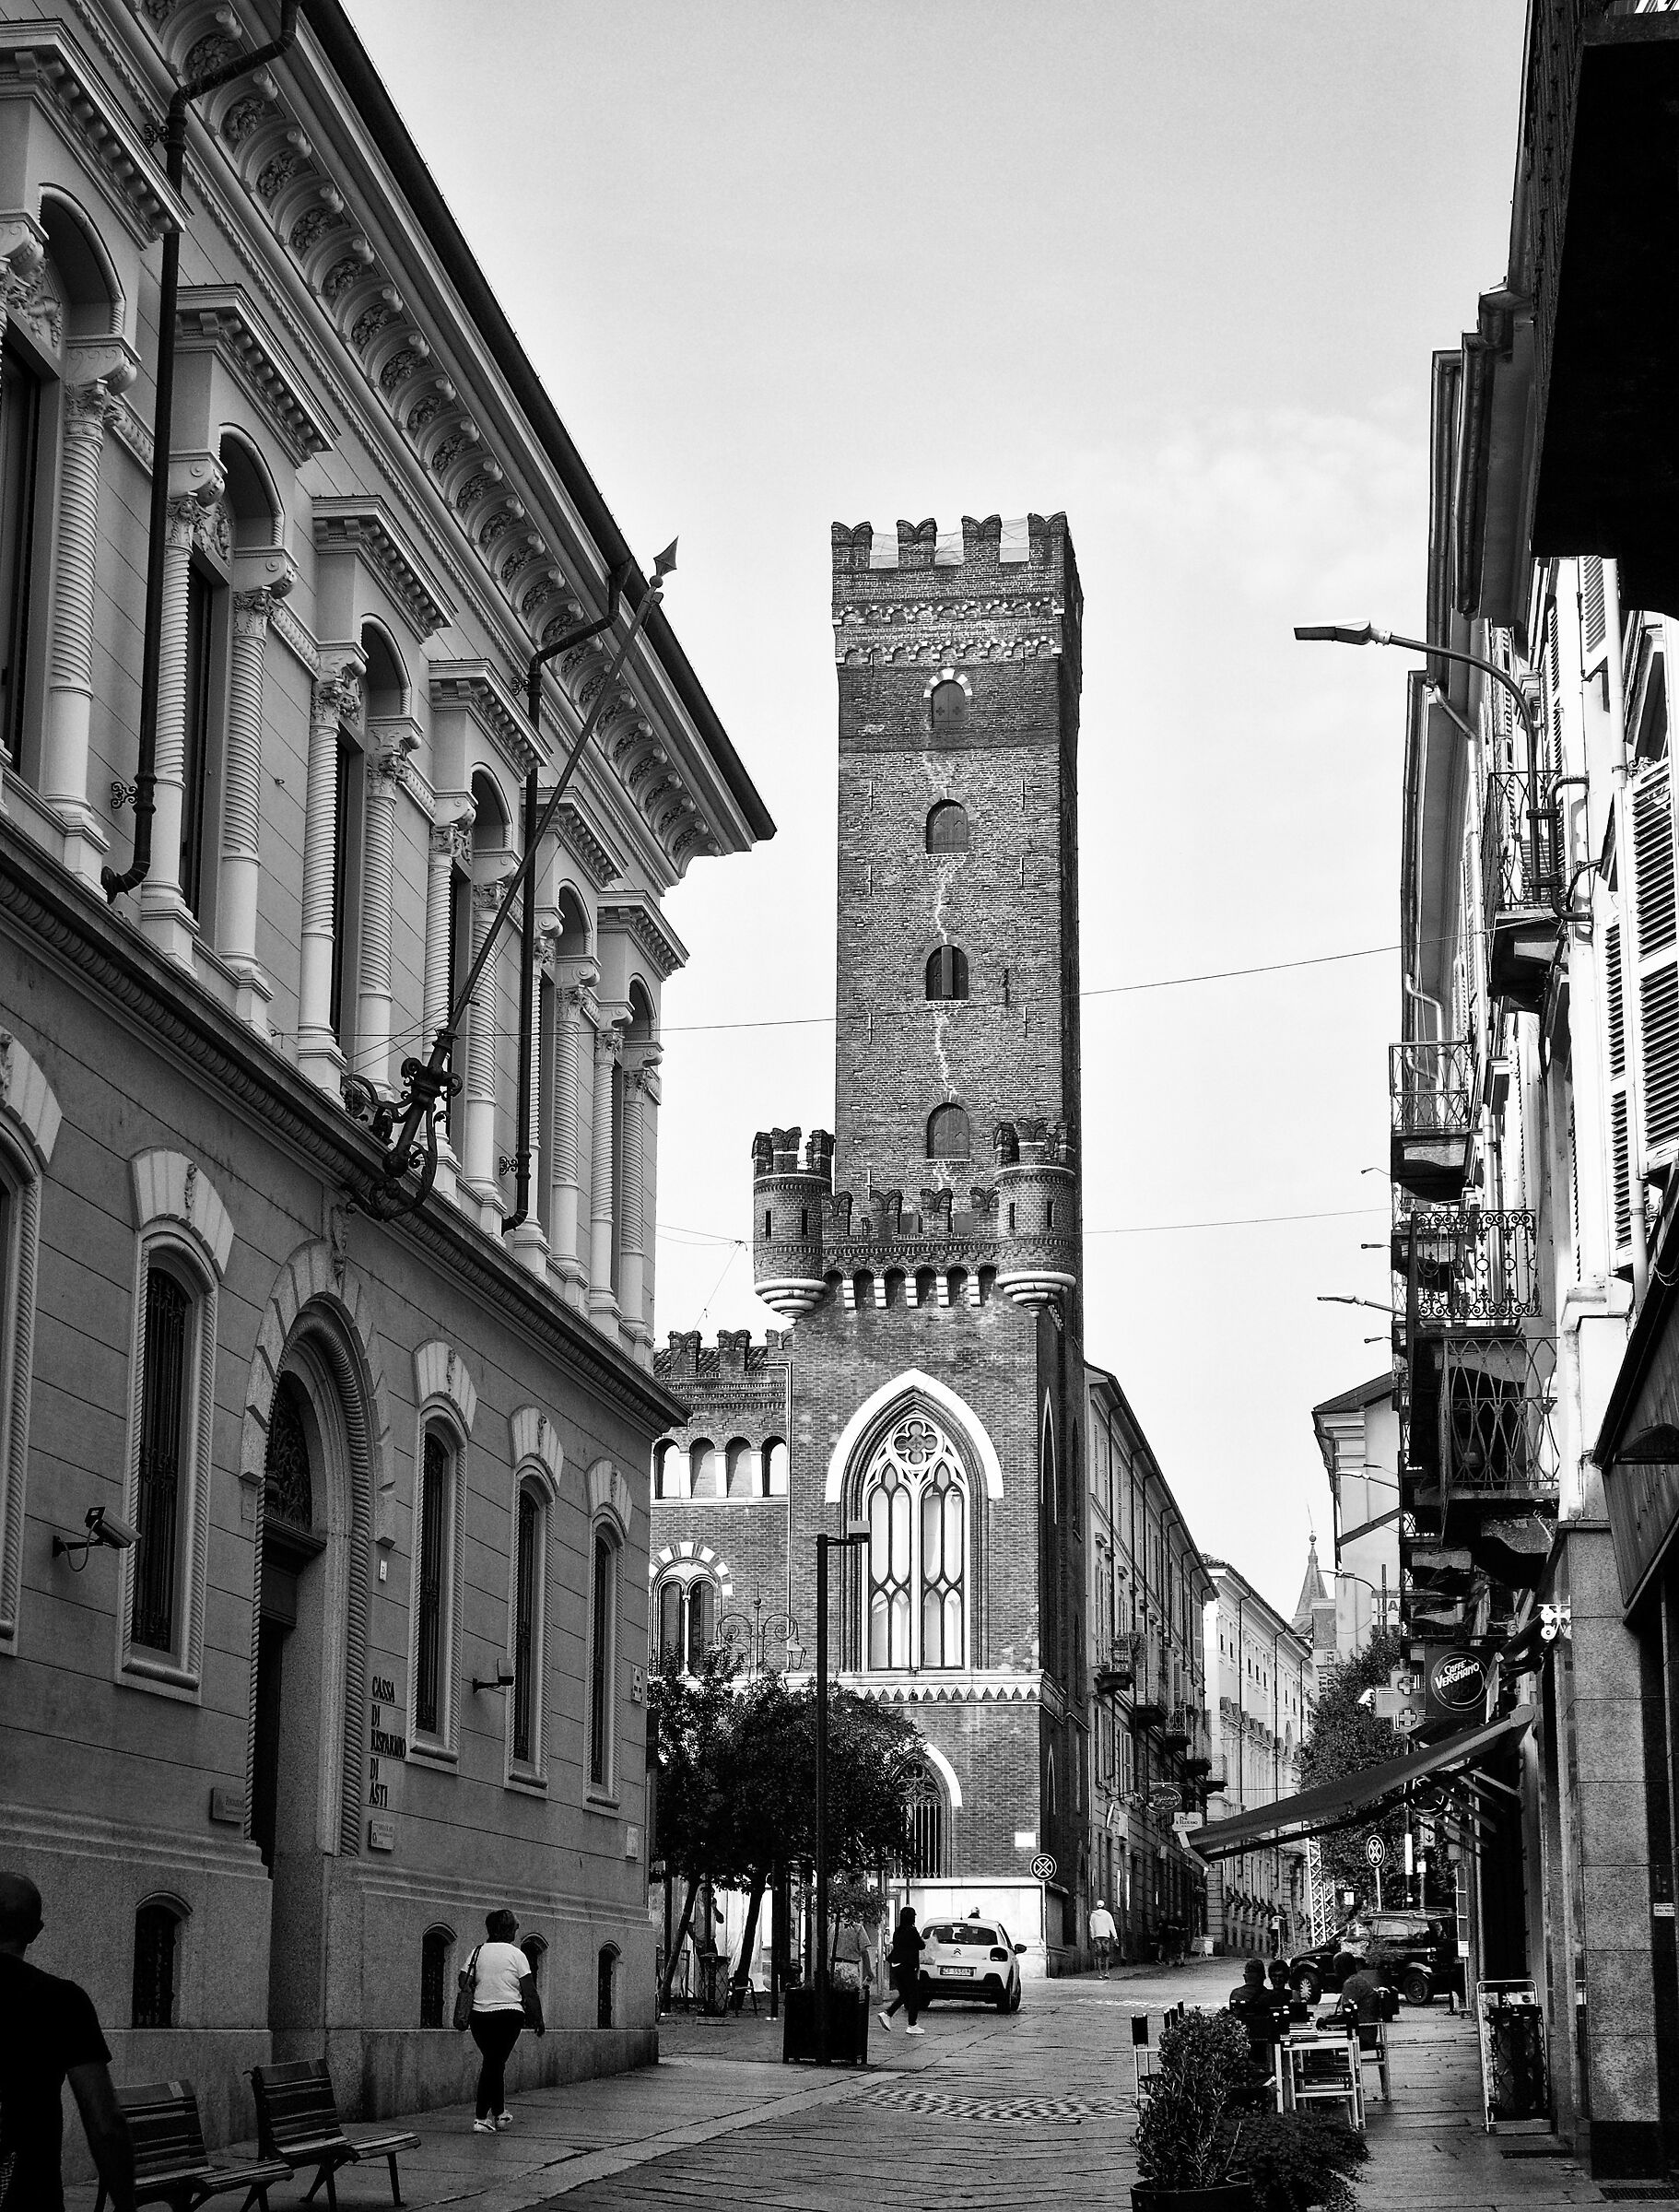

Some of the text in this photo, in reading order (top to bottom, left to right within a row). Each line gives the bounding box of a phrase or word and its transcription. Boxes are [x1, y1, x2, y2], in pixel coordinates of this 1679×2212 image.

[1434, 1662, 1480, 1689] VERGNANO
[371, 1676, 395, 1704] CASSA
[370, 1704, 381, 1727] DI
[370, 1728, 406, 1759] RISPARMIO
[370, 1757, 379, 1781] DI
[369, 1782, 388, 1808] ASTI
